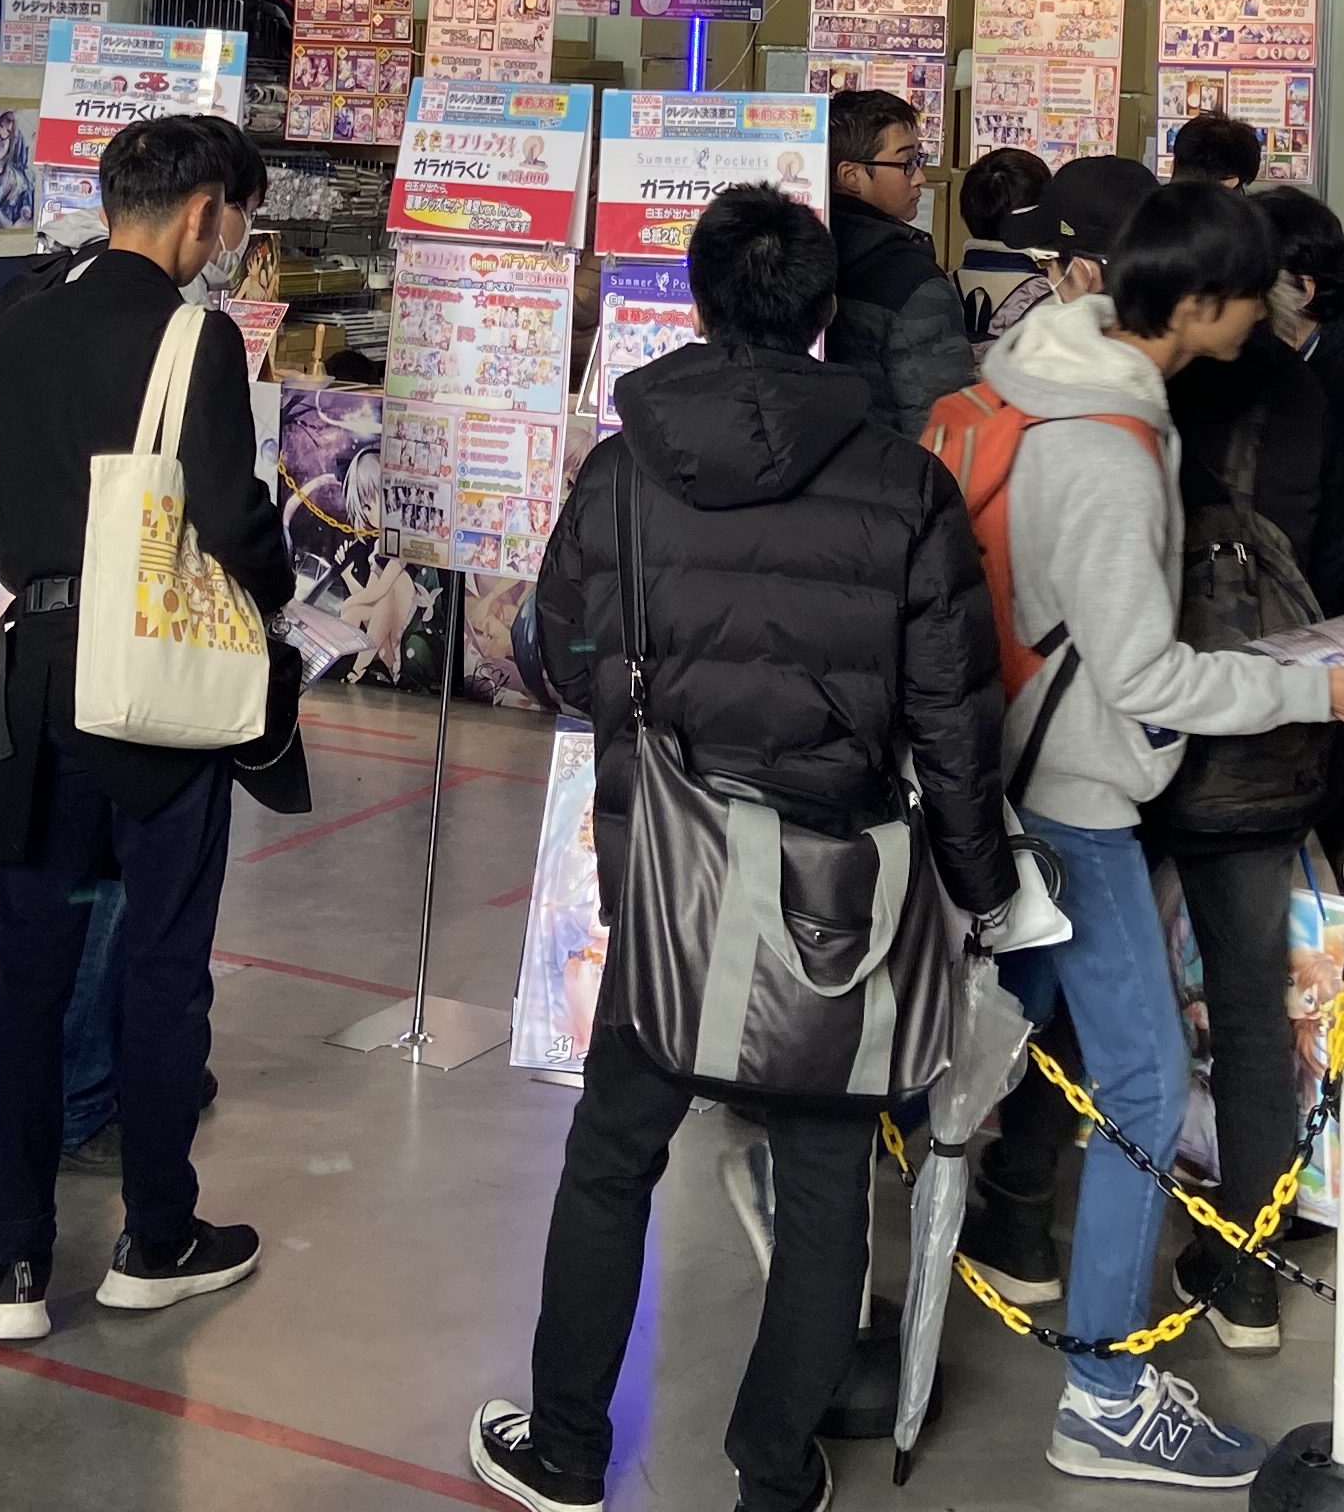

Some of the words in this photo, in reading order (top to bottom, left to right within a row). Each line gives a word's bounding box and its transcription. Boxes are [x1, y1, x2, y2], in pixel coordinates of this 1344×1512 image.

[10, 0, 101, 16] クレジット決済窓口
[666, 106, 736, 120] クレジット決済窓口
[746, 107, 799, 122] 事前決済
[637, 152, 689, 166] Summer
[715, 154, 770, 168] Pockets
[413, 157, 491, 180] ガラガラくじ
[641, 228, 680, 245] 色紙2枚
[471, 259, 497, 272] Remix
[610, 275, 653, 287] Summer
[1139, 1412, 1193, 1461] N
